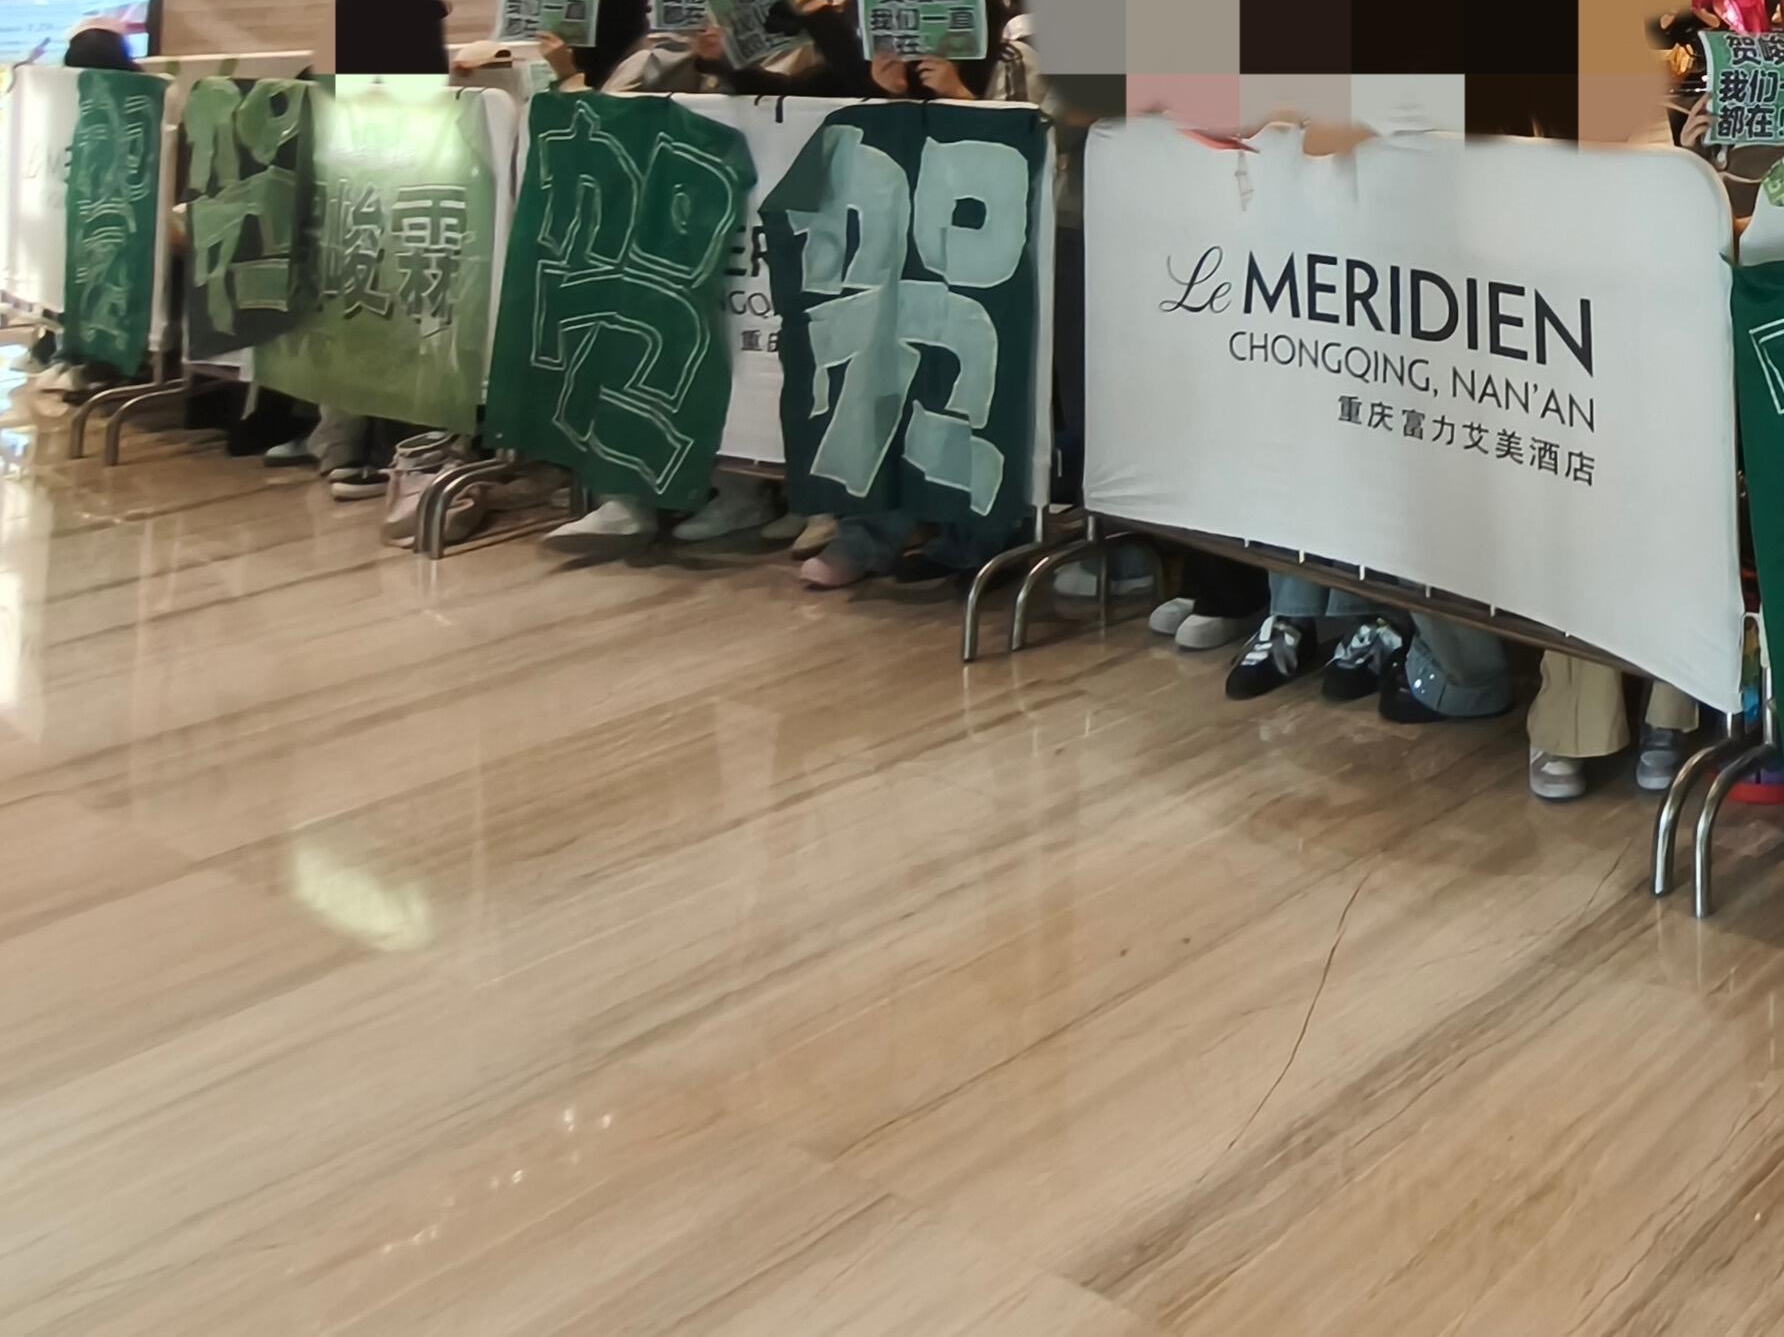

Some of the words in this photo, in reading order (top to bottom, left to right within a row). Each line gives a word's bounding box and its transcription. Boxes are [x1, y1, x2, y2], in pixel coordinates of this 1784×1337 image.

[1158, 245, 1232, 314] Le
[1243, 250, 1595, 378] MERIDIEN
[1228, 331, 1439, 399] CHONGQING,
[1338, 395, 1597, 487] 重庆富力艾美酒店
